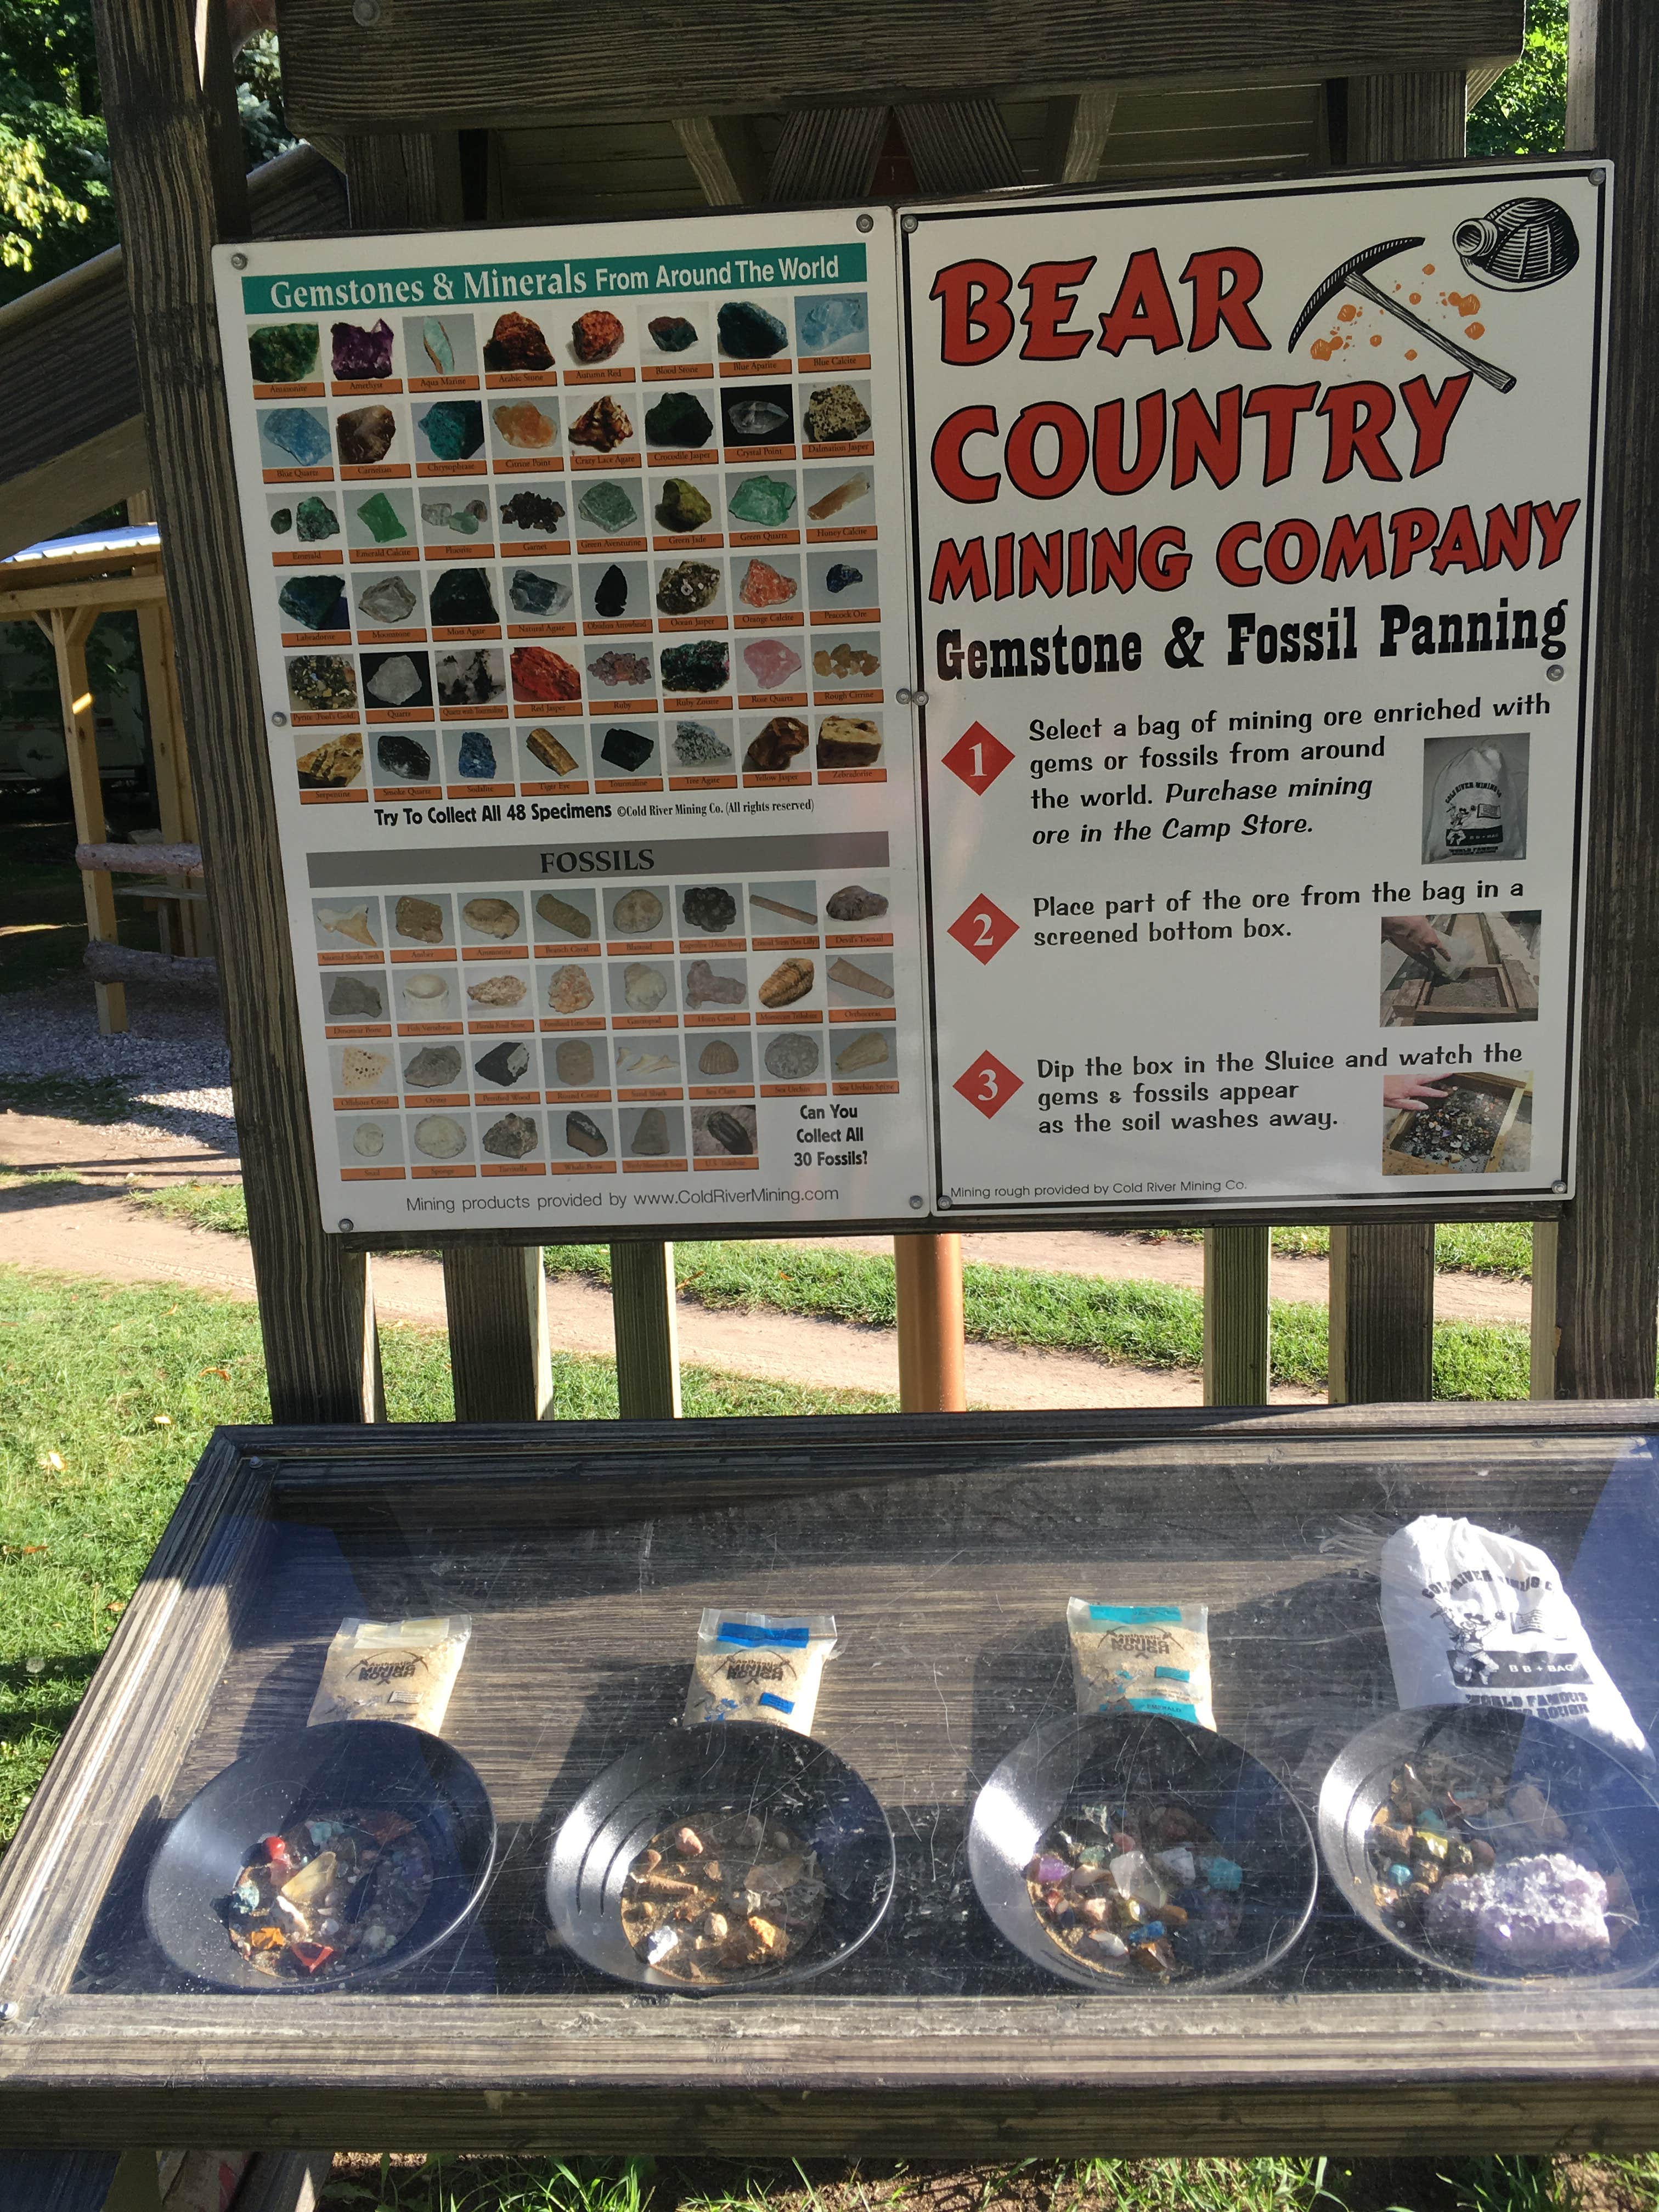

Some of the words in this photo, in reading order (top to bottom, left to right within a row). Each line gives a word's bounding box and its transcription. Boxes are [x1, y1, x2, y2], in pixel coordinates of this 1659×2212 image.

[270, 280, 424, 308] Gemstones
[433, 273, 455, 301] &
[464, 263, 587, 299] Minerals
[595, 268, 648, 291] From
[656, 261, 731, 288] Around
[735, 260, 774, 283] The
[777, 255, 839, 281] World
[929, 247, 1271, 366] BEAR
[607, 369, 622, 377] Red
[656, 366, 676, 375] Blood
[679, 365, 698, 374] Stone
[931, 371, 1472, 504] COUNTRY
[654, 452, 687, 461] Crocodile
[690, 452, 710, 461] Jasper
[736, 449, 761, 458] Crystal
[817, 529, 841, 538] Honey
[523, 543, 548, 551] Garnet
[929, 525, 1192, 604] MINING
[1216, 499, 1581, 587] COMPANY
[292, 552, 321, 560] Emerald
[671, 618, 692, 627] Ocean
[695, 618, 714, 627] Jasper
[742, 614, 768, 624] Orange
[770, 613, 794, 622] Calcite
[936, 624, 1142, 680] Gemstone
[1164, 616, 1205, 669] &
[1227, 607, 1357, 665] Fossil
[1380, 599, 1568, 659] Panning
[387, 710, 411, 718] Quartz
[546, 704, 566, 713] Jasper
[1029, 718, 1102, 742] Select
[1114, 723, 1126, 737] a
[1138, 715, 1180, 740] bag
[1191, 710, 1217, 733] of
[1229, 710, 1312, 733] mining
[1324, 710, 1362, 727] ore
[1374, 697, 1481, 724] enriched
[1492, 692, 1550, 717] with
[969, 743, 987, 776] 1
[1030, 757, 1093, 780] gems
[1104, 756, 1128, 771] or
[1139, 744, 1218, 769] fossils
[1229, 742, 1289, 765] from
[1301, 736, 1385, 761] around
[833, 770, 872, 778] Zebradorite
[315, 791, 350, 799] Serpentine
[539, 782, 556, 791] Tiger
[559, 782, 570, 791] Eye
[1030, 788, 1069, 810] the
[1080, 784, 1153, 808] world.
[1165, 780, 1277, 804] Purchase
[1288, 777, 1373, 801] mining
[374, 809, 398, 827] Try
[403, 808, 423, 826] To
[427, 806, 477, 825] Collect
[482, 805, 501, 822] All
[506, 804, 526, 821] 48
[531, 803, 612, 823] Specimens
[617, 805, 647, 818] ©Cold
[649, 805, 673, 817] River
[675, 804, 707, 818] Mining
[709, 803, 724, 815] Co.
[725, 802, 741, 817] (All
[743, 801, 770, 816] rights
[772, 799, 814, 813] reserved)
[1032, 830, 1070, 845] ore
[1080, 825, 1102, 843] in
[1114, 820, 1152, 842] the
[1162, 818, 1231, 843] Camp
[1241, 814, 1312, 836] Store.
[540, 849, 654, 874] FOSSILS
[1033, 896, 1095, 918] Place
[1105, 894, 1155, 920] part
[1166, 890, 1192, 912] of
[1202, 889, 1241, 911] the
[1252, 894, 1290, 909] ore
[1300, 885, 1360, 906] from
[1372, 882, 1411, 904] the
[1423, 881, 1465, 906] bag
[1477, 881, 1498, 899] in
[1510, 883, 1523, 897] a
[973, 913, 994, 946] 2
[1034, 923, 1138, 946] screened
[1149, 921, 1232, 943] bottom
[1244, 918, 1291, 939] box.
[1037, 1059, 1074, 1083] Dip
[1085, 1057, 1122, 1077] the
[1133, 1056, 1173, 1076] box
[1184, 1057, 1205, 1074] in
[1216, 1052, 1254, 1073] the
[1265, 1051, 1334, 1071] Sluice
[1345, 1047, 1387, 1068] and
[1399, 1044, 1472, 1066] watch
[1483, 1042, 1522, 1063] the
[978, 1069, 998, 1101] 3
[1038, 1091, 1098, 1111] gems
[1109, 1091, 1121, 1104] &
[1133, 1082, 1209, 1103] fossils
[1220, 1086, 1299, 1105] appear
[800, 1105, 825, 1120] Can
[830, 1104, 858, 1119] You
[1039, 1120, 1064, 1135] as
[1074, 1113, 1111, 1133] the
[1122, 1111, 1160, 1132] soil
[1171, 1109, 1259, 1130] washes
[1269, 1113, 1338, 1131] away.
[796, 1128, 842, 1144] Collect
[845, 1127, 864, 1143] All
[794, 1152, 812, 1167] 30
[817, 1150, 868, 1167] Fossils?
[950, 1187, 991, 1200] Mining
[995, 1186, 1030, 1199] rough
[1034, 1184, 1090, 1198] provided
[1093, 1184, 1109, 1196] by
[1113, 1183, 1143, 1194] Cold
[1147, 1182, 1176, 1193] River
[1181, 1181, 1221, 1193] Mining
[1225, 1180, 1247, 1190] Co.
[407, 1198, 455, 1214] Mining
[462, 1196, 530, 1213] products
[537, 1193, 602, 1211] provided
[609, 1193, 627, 1209] by
[633, 1188, 839, 1205] www.ColdRiverMining.com
[1111, 1637, 1170, 1647] MINING
[1111, 1644, 1170, 1655] ROUGH
[358, 1670, 416, 1681] ROUGH
[360, 1664, 416, 1674] MINING
[727, 1664, 784, 1674] MINING
[1526, 1691, 1588, 1707] FAMOUS
